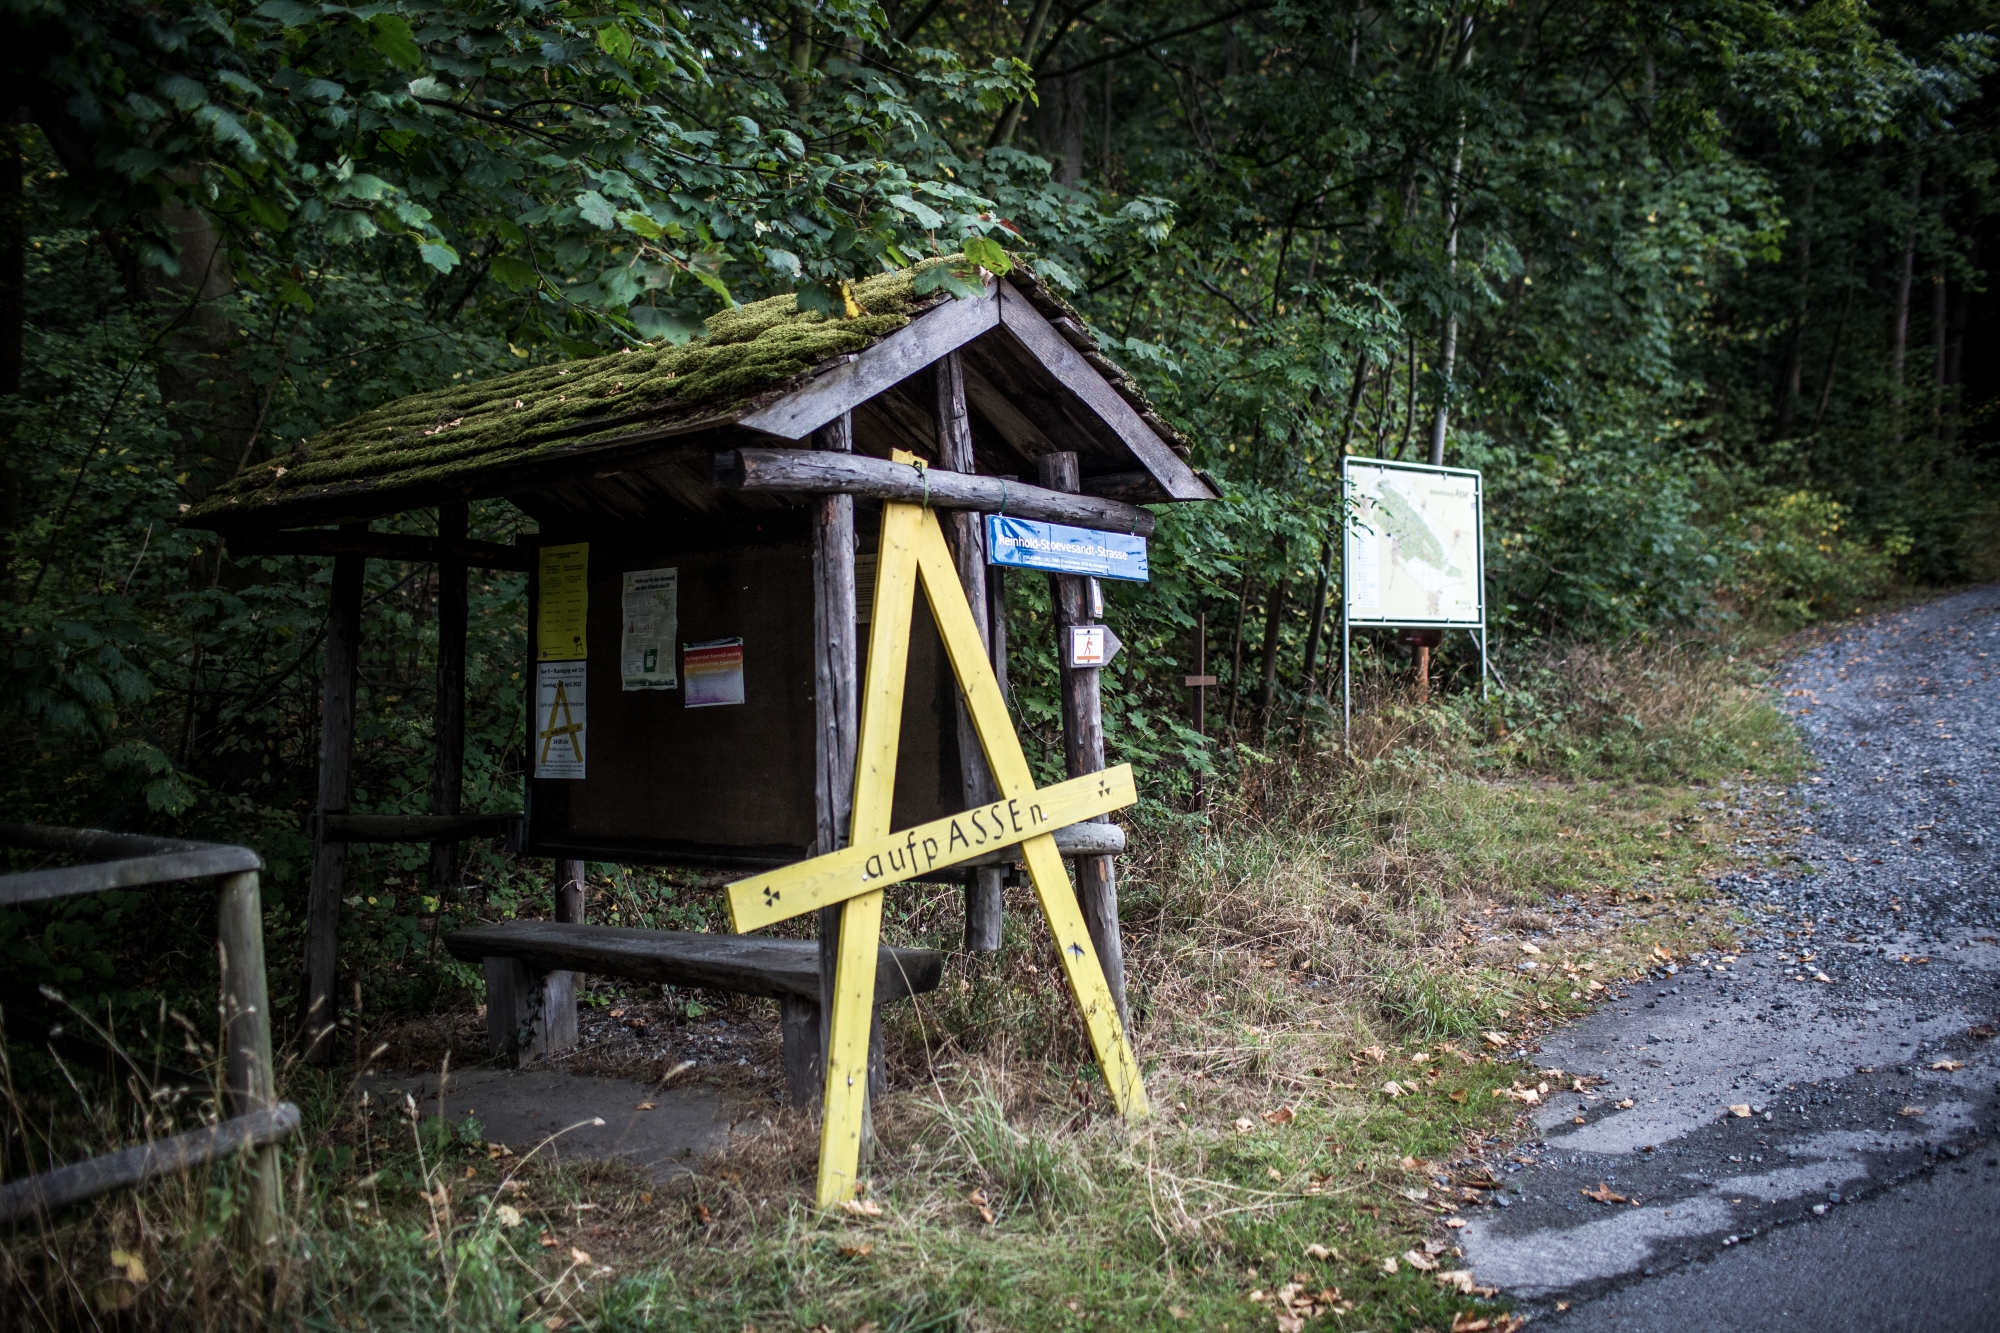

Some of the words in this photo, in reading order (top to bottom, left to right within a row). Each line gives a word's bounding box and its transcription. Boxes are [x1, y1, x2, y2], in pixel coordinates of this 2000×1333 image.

[1456, 489, 1469, 498] Asse
[998, 533, 1128, 560] Reinhold-Stoevesandt-Strasse
[865, 798, 1044, 879] aufpASSEn
